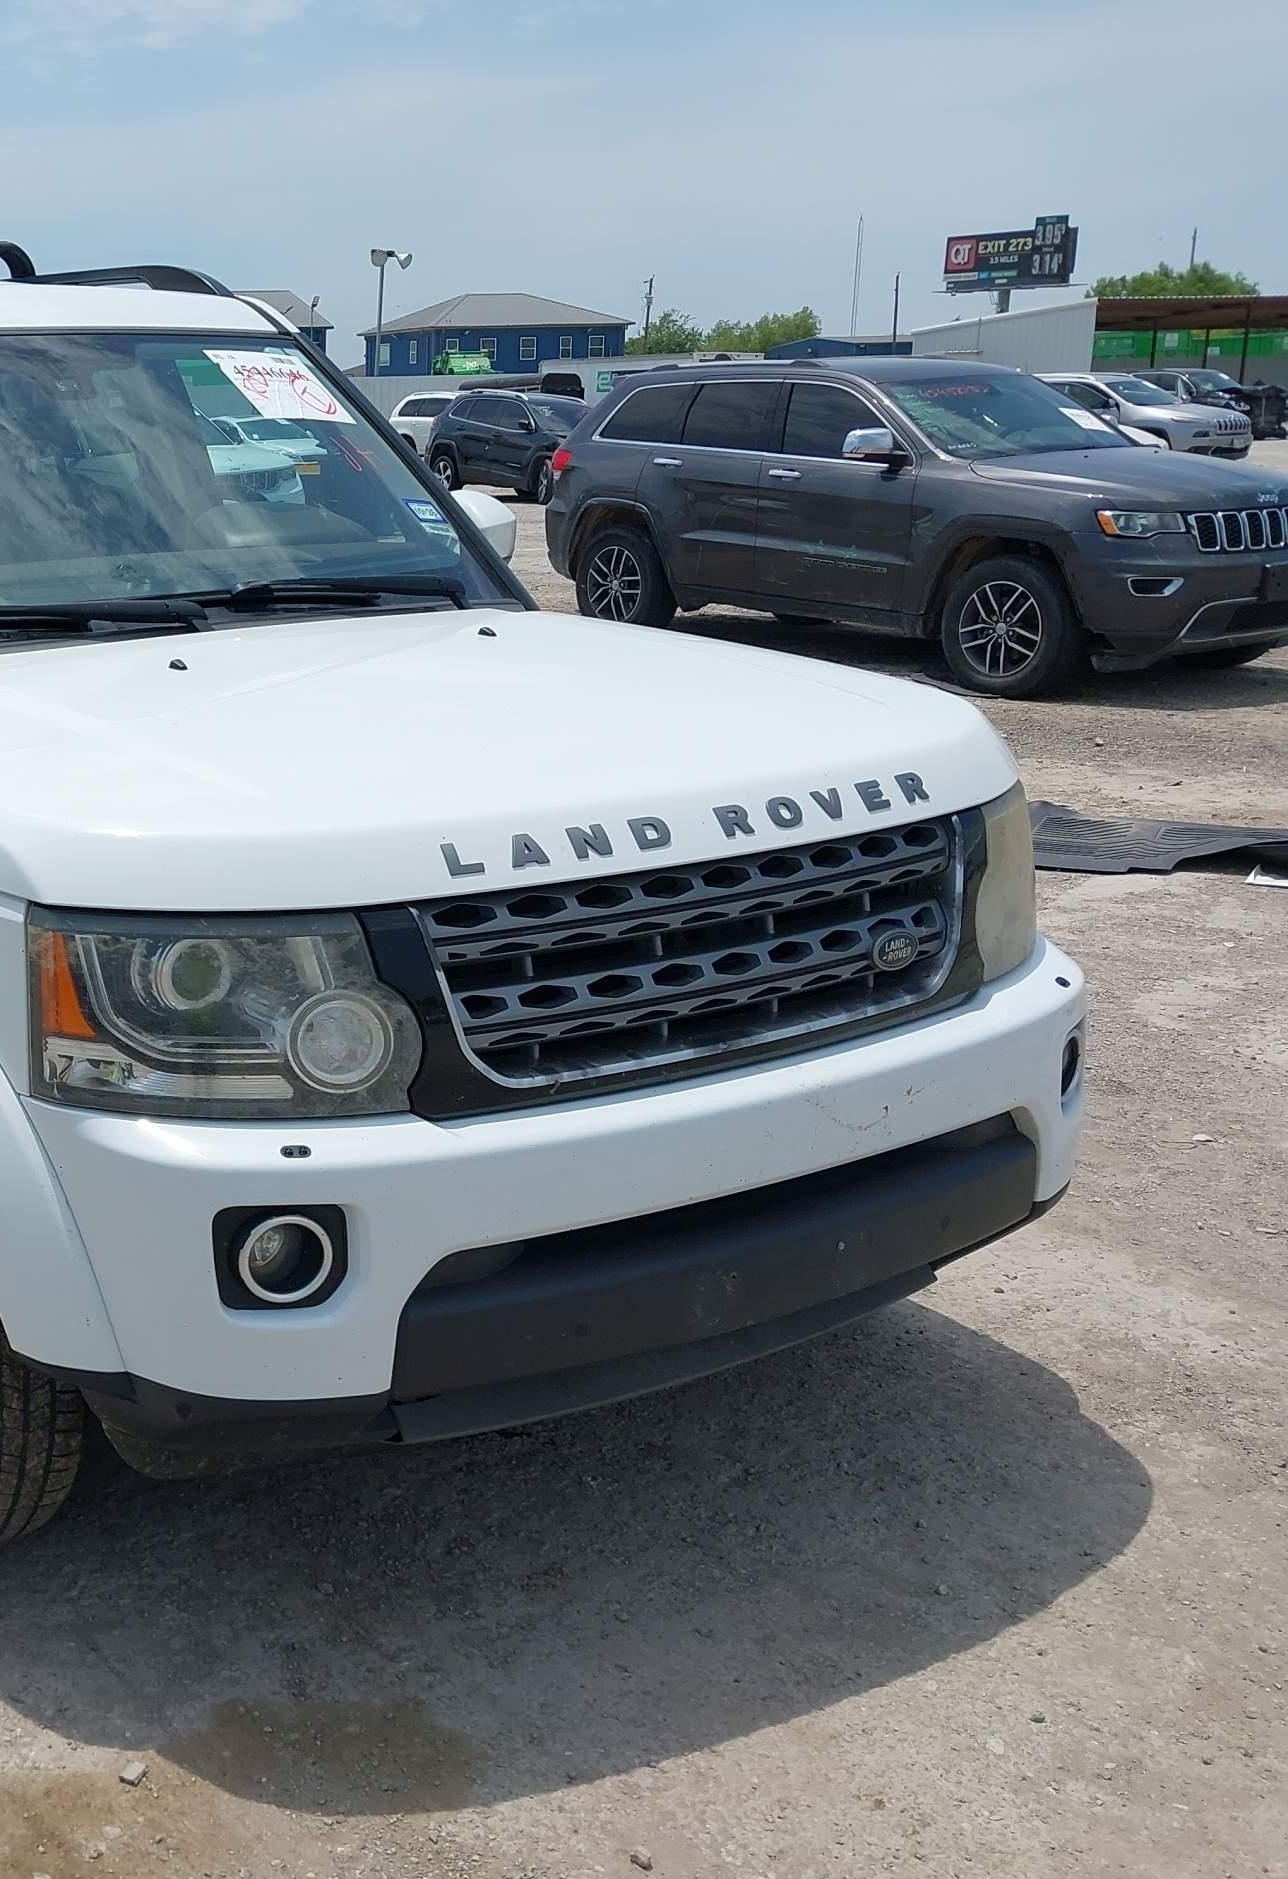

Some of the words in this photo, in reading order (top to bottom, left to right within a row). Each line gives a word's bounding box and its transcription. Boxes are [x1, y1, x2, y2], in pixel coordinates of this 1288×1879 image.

[978, 240, 1006, 254] EXIT
[1008, 237, 1033, 252] 273
[951, 244, 972, 265] QT
[1000, 255, 1018, 264] MILES
[440, 816, 672, 879] LAND
[712, 771, 931, 840] ROVER
[885, 938, 906, 952] LAND
[887, 946, 912, 961] ROVER
